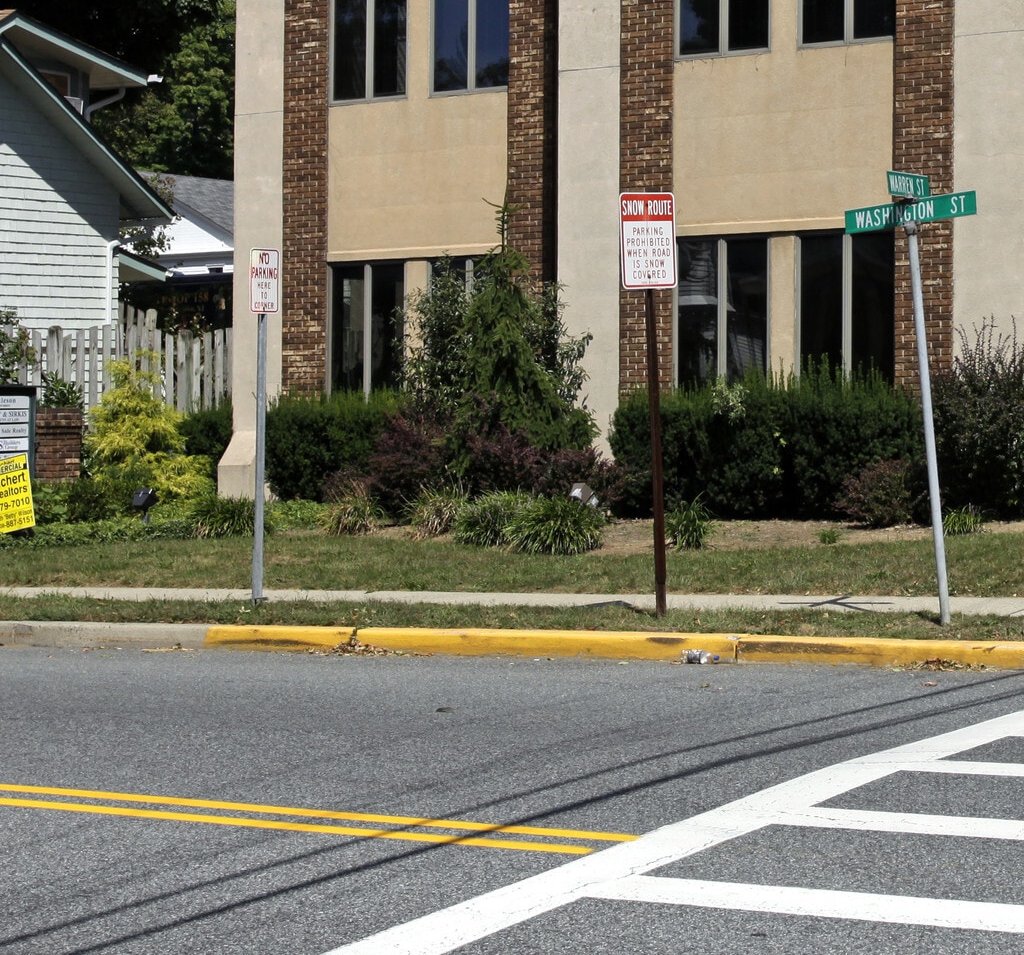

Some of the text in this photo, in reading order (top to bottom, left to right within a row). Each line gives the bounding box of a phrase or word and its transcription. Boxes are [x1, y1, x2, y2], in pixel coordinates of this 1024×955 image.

[888, 174, 924, 196] WARREN ST
[622, 200, 673, 216] SNOW ROUTE
[855, 195, 966, 229] WASHINGTON ST
[632, 226, 663, 236] PARKING
[626, 237, 670, 247] PROHIBITED
[258, 252, 270, 265] NO
[627, 248, 671, 258] WHEN ROAD
[633, 259, 665, 269] IS SNOW
[251, 266, 278, 280] PARKING
[632, 269, 667, 280] COVERED
[257, 281, 271, 290] HERE
[261, 291, 268, 300] TO
[254, 301, 275, 310] CORNER
[0, 471, 26, 487] chert
[0, 485, 28, 499] ealtors
